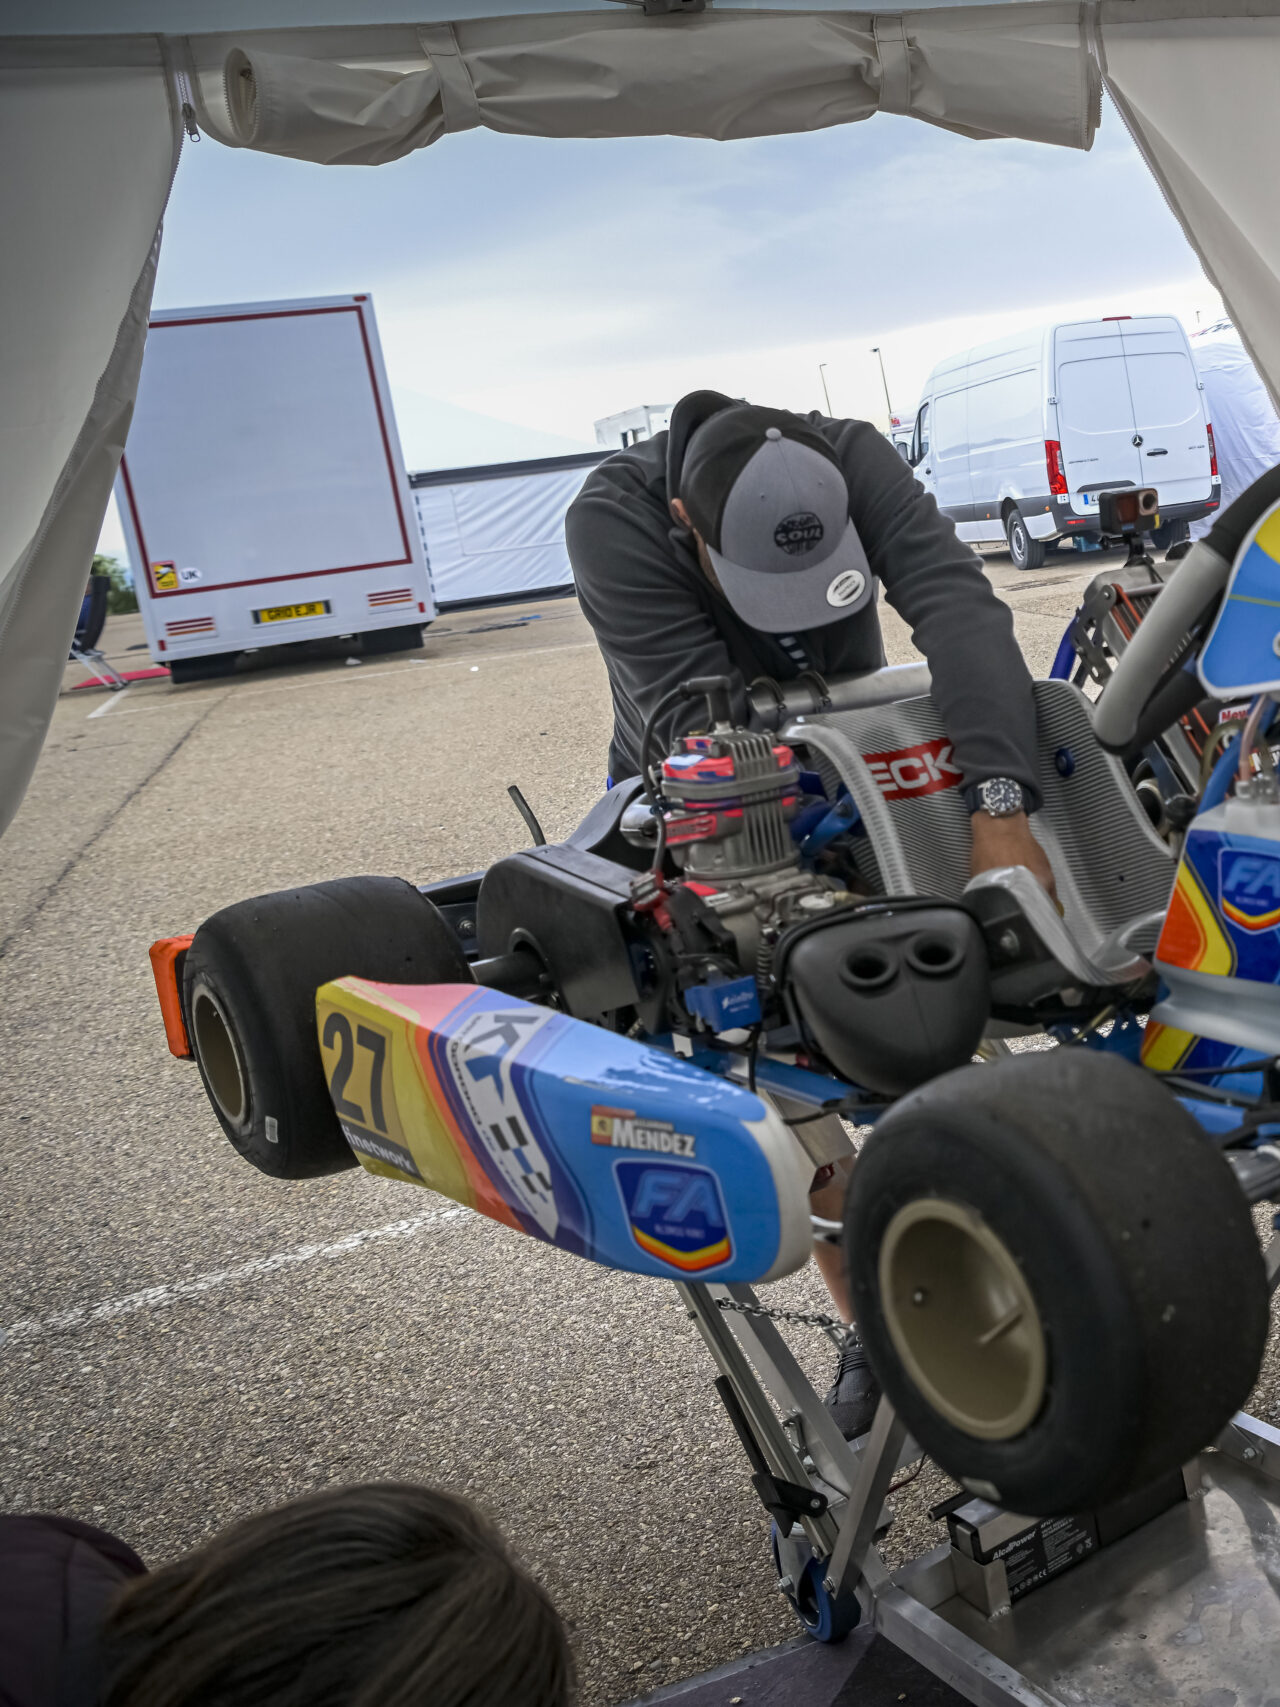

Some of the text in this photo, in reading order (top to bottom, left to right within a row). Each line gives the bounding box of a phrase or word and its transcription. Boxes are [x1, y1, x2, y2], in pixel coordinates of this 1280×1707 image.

[181, 570, 199, 581] UK
[323, 1012, 389, 1134] 27
[611, 1118, 696, 1158] MENDEZ
[631, 1169, 724, 1227] FA
